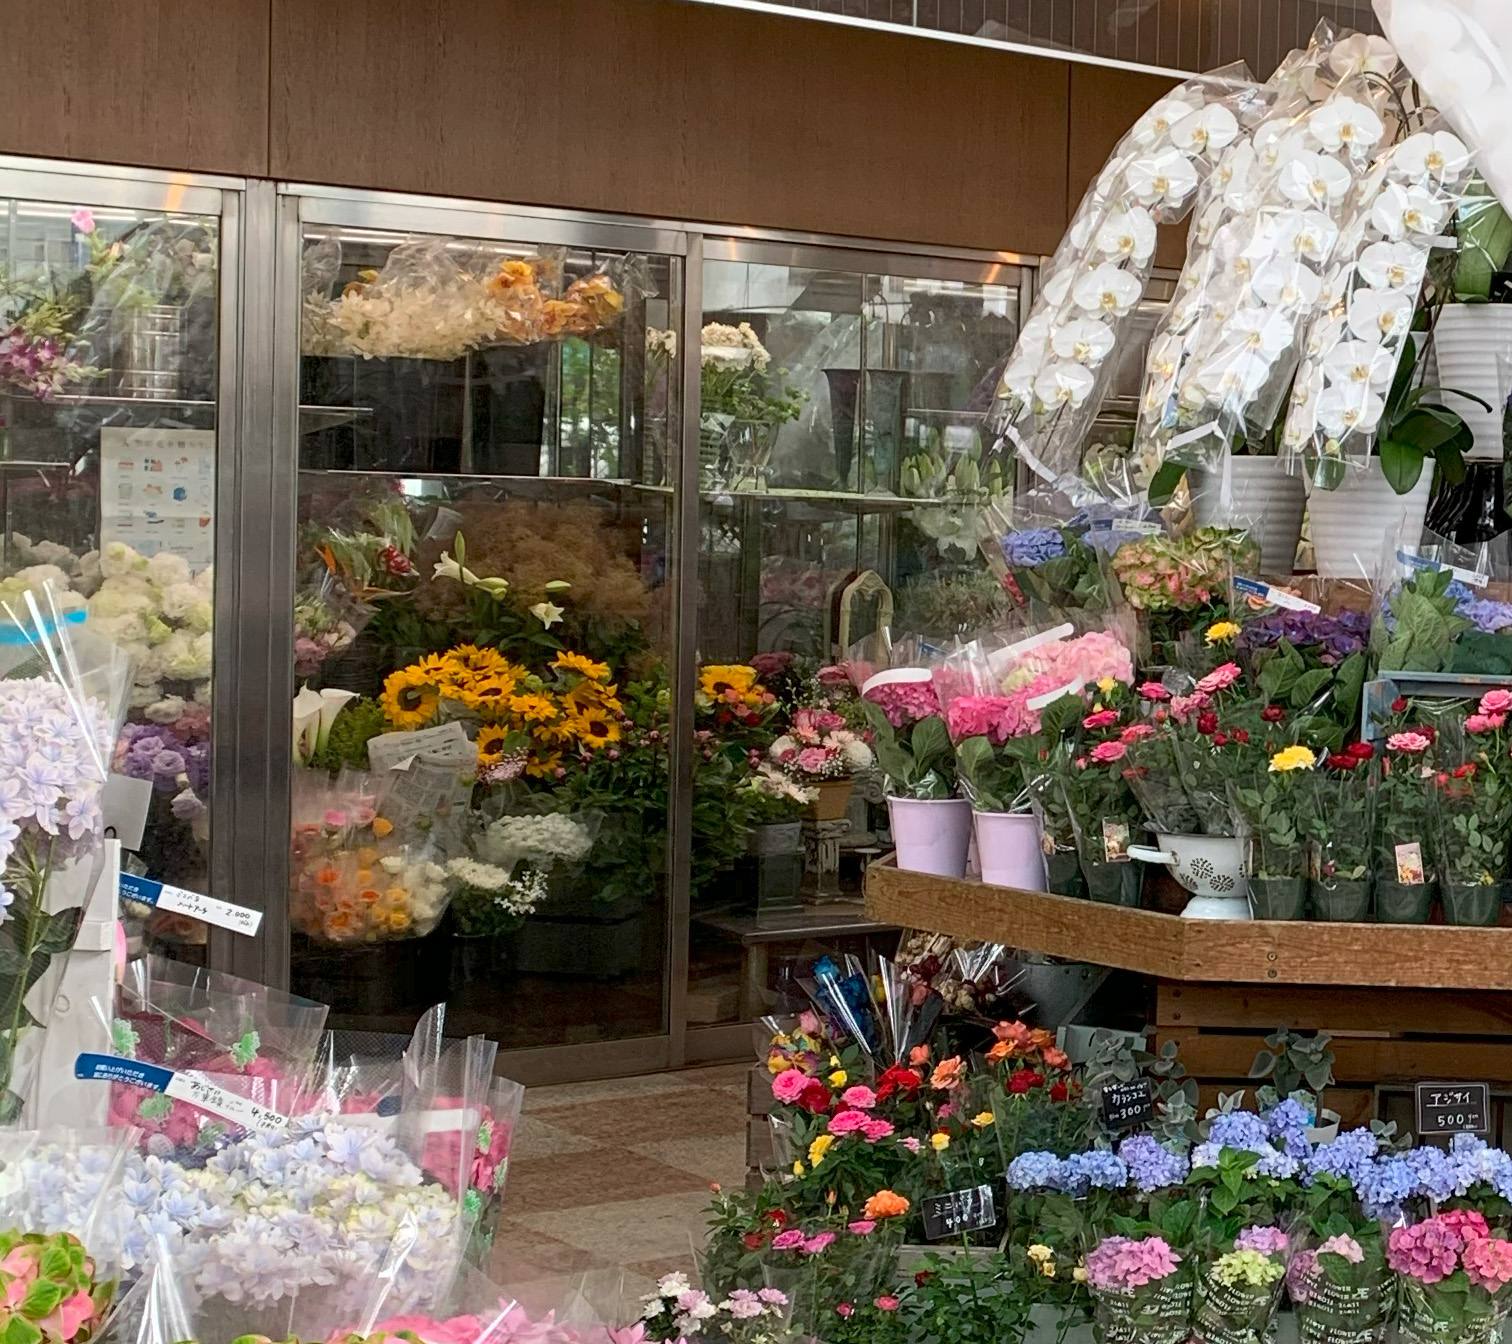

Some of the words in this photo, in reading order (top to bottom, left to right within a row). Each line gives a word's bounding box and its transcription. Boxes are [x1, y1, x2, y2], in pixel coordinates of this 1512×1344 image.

[1430, 1091, 1470, 1106] アジサイ
[1120, 1105, 1141, 1119] 300
[1438, 1114, 1464, 1127] 500
